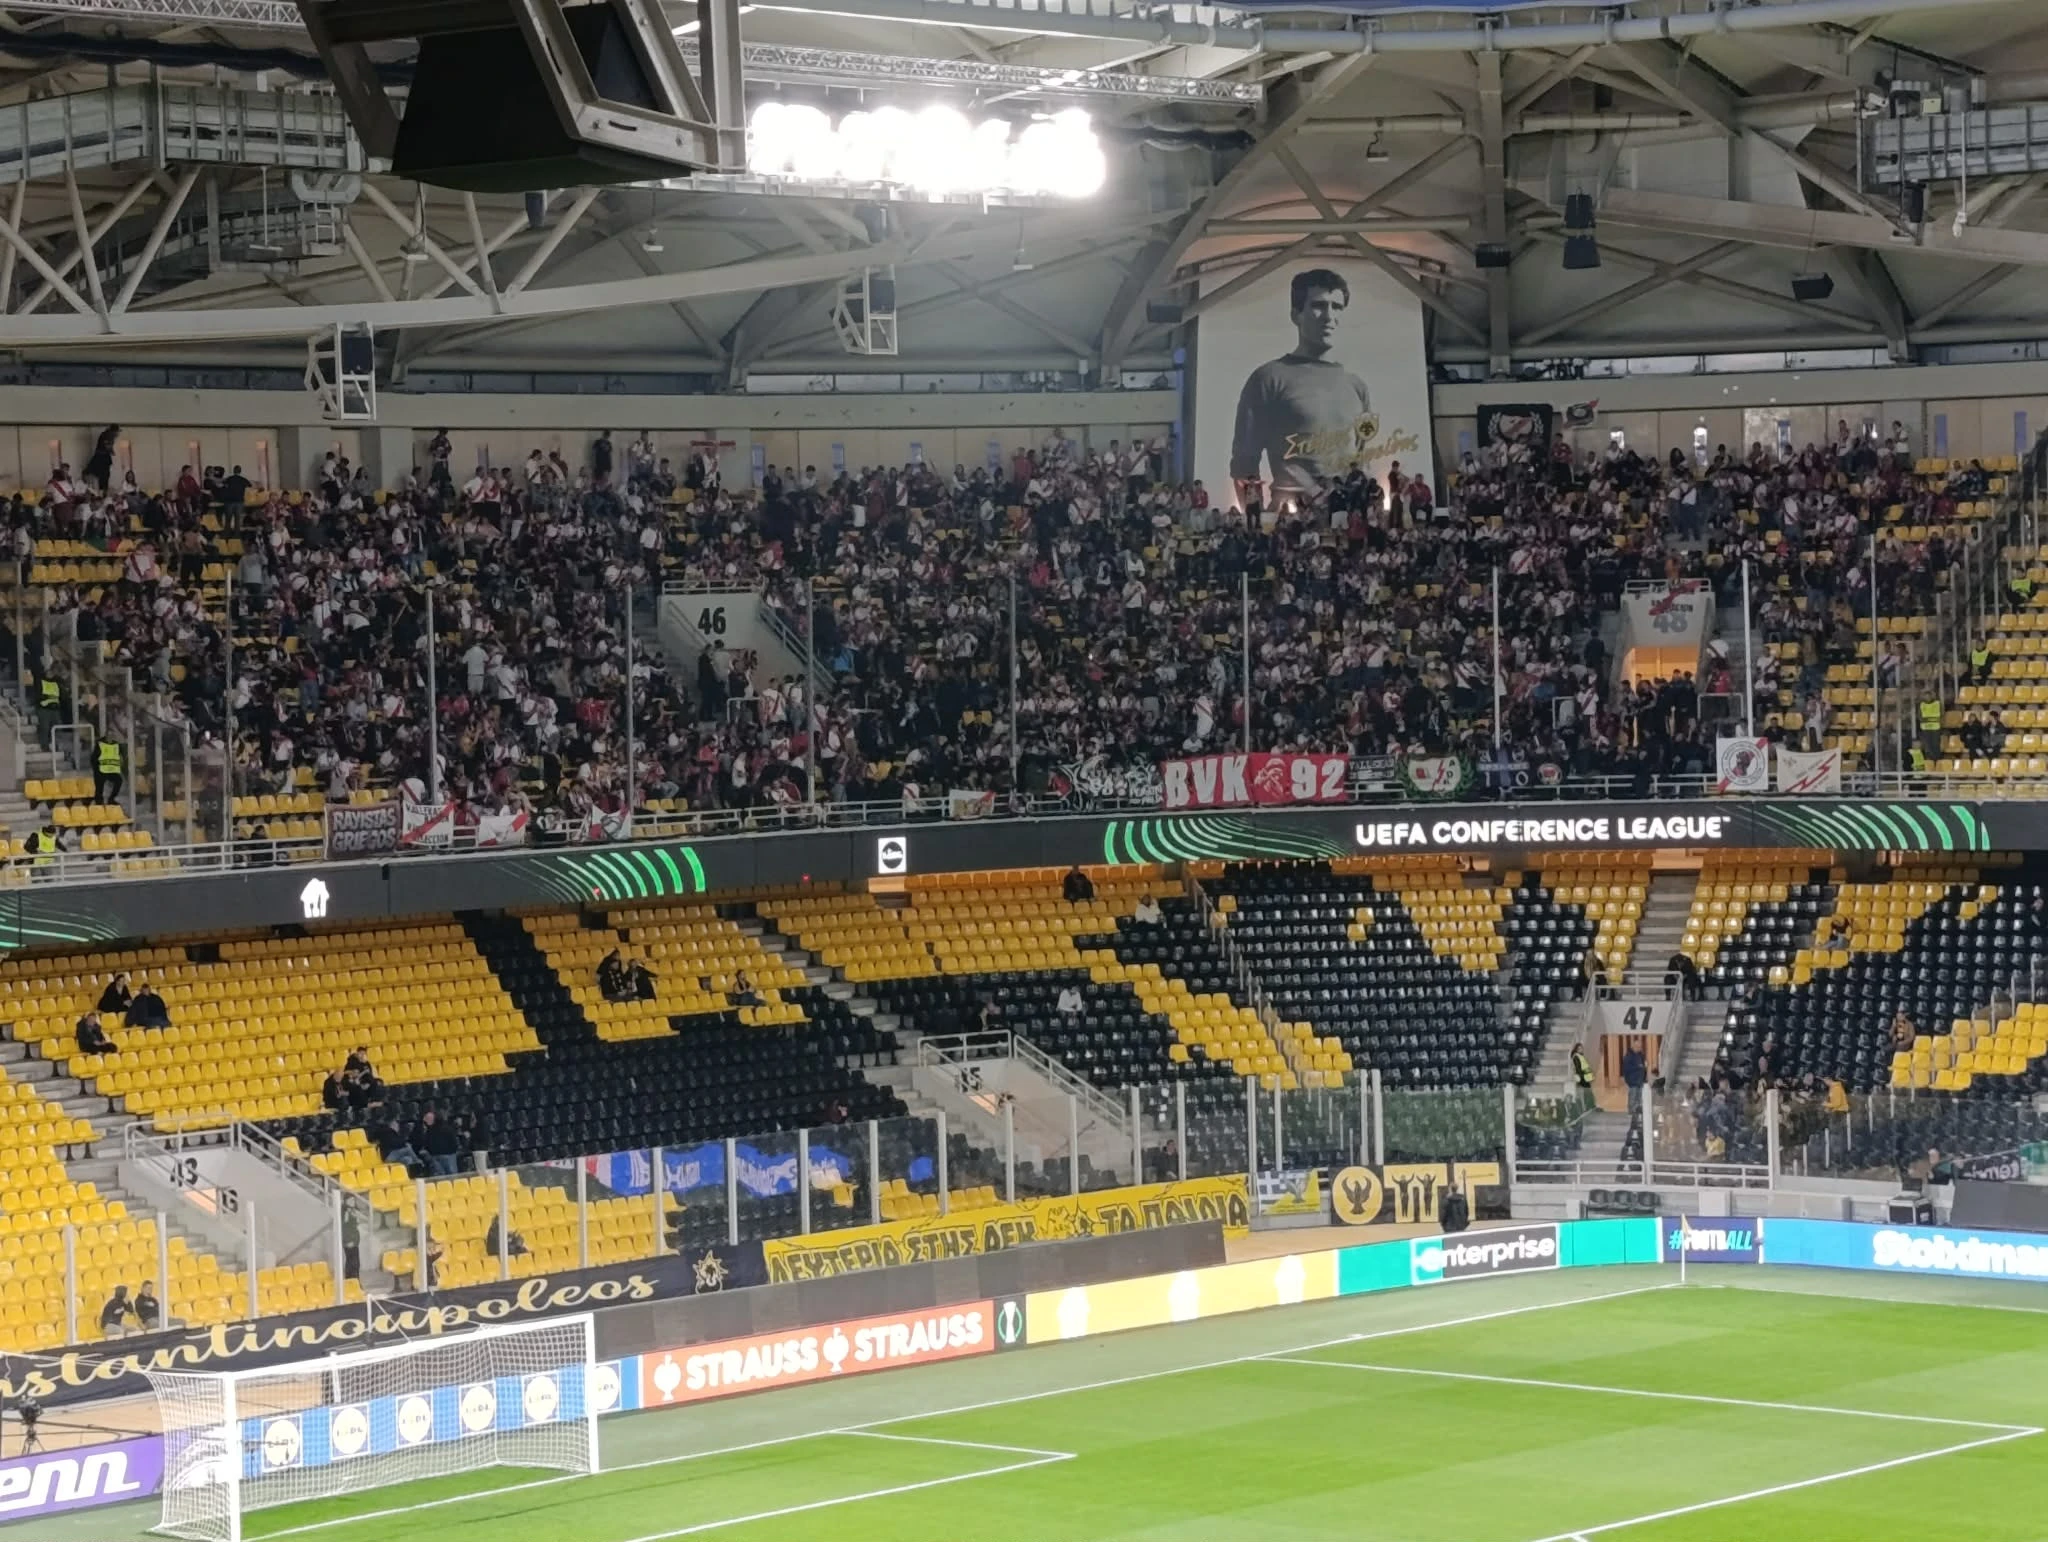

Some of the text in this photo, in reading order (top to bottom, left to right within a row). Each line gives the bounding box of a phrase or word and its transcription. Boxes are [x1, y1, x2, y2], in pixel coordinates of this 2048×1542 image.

[698, 607, 726, 635] 46
[1165, 755, 1250, 808] BVK
[1291, 758, 1345, 799] 92
[1356, 816, 1723, 846] UEFA CONFERENCE LEAGUE
[1623, 1006, 1653, 1030] 47
[1418, 1234, 1556, 1272] enterprise
[854, 1311, 984, 1363] STRAUSS
[686, 1336, 820, 1391] STRAUSS
